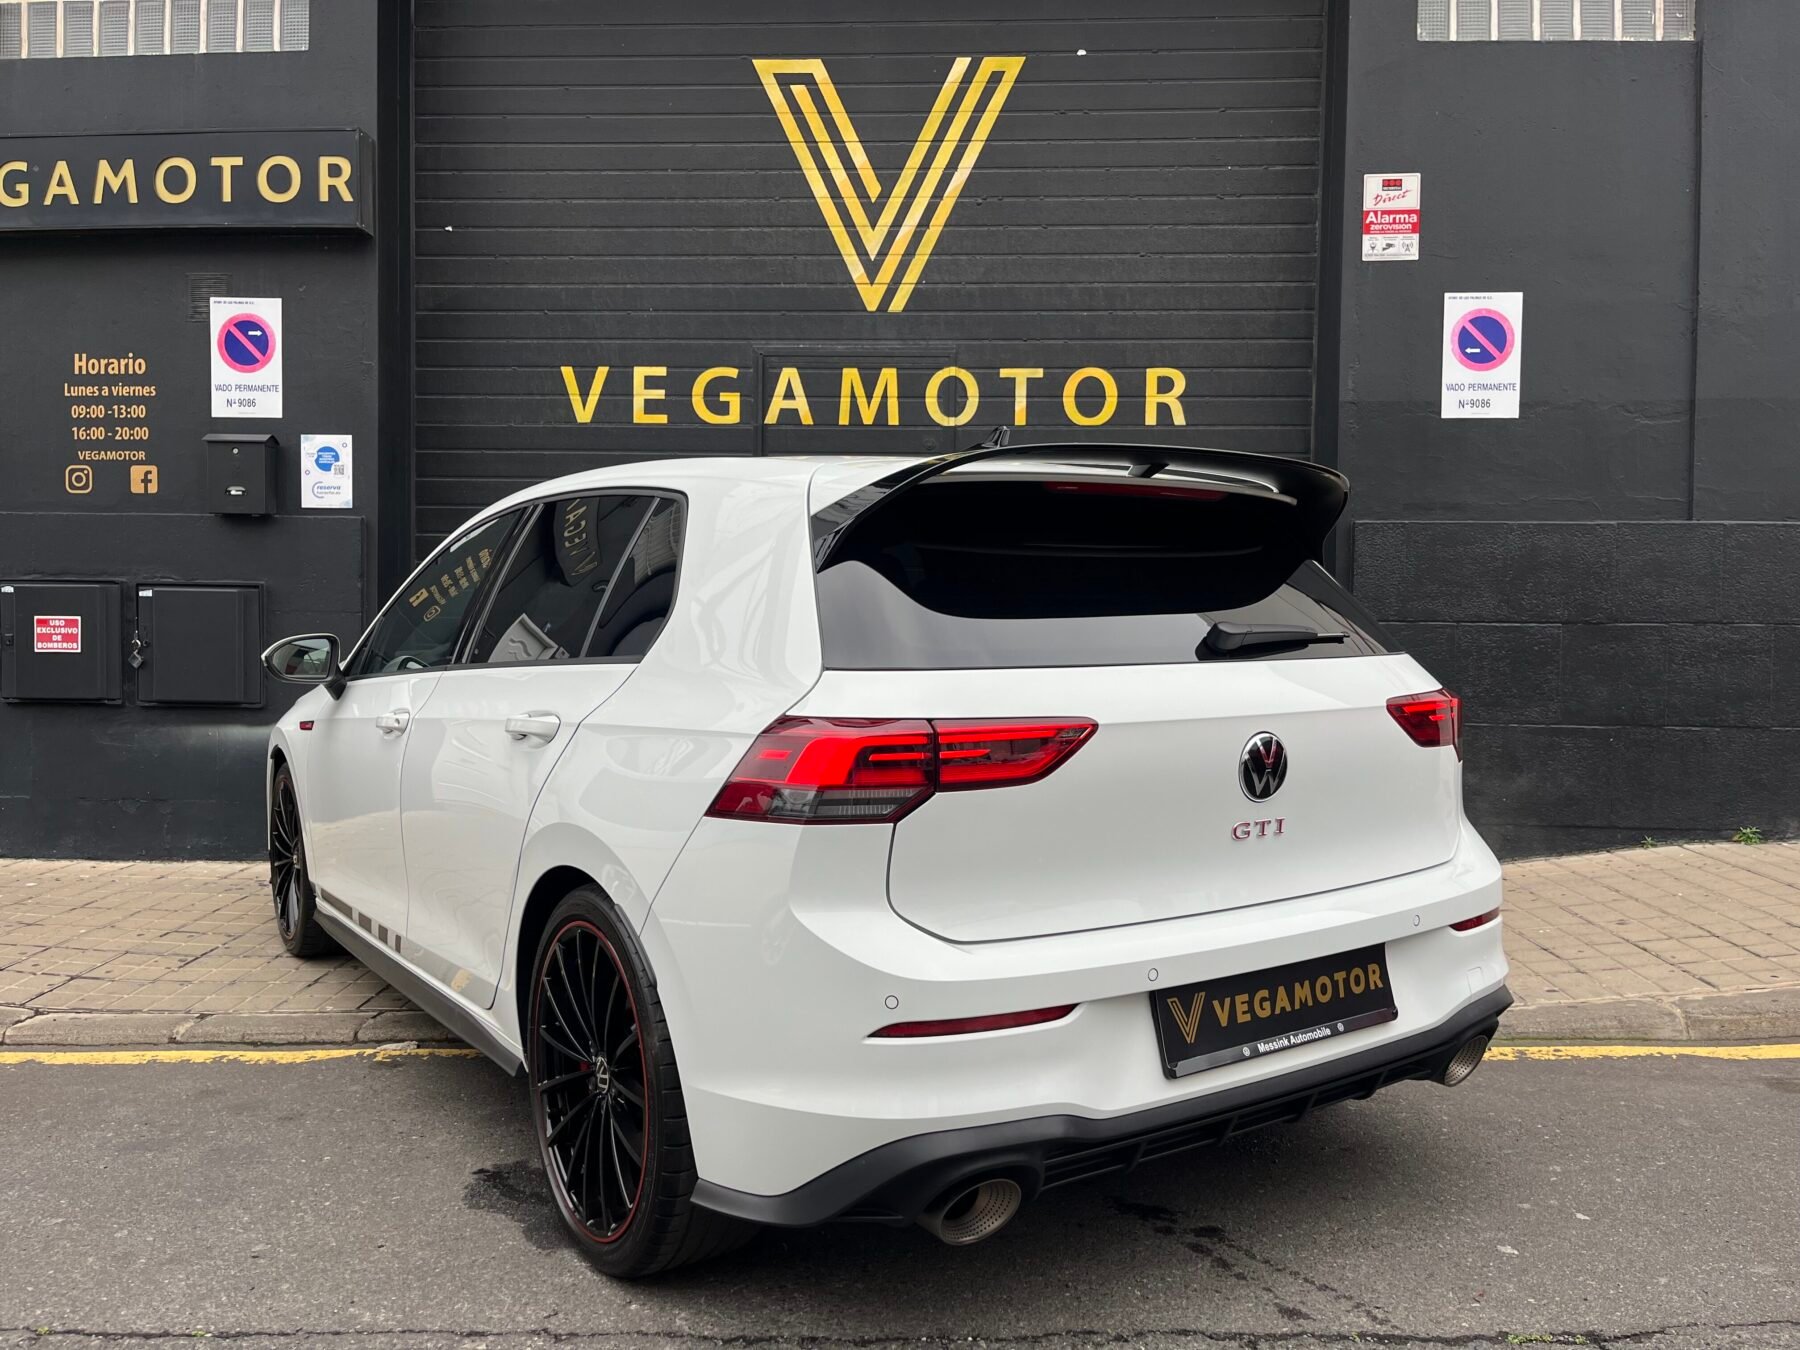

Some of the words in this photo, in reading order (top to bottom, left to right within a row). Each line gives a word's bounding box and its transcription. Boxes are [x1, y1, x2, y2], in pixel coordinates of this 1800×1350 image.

[1373, 189, 1412, 207] Direct
[1365, 211, 1418, 224] Alarma
[1370, 223, 1412, 231] zerovision
[74, 352, 146, 375] Horario
[64, 383, 99, 396] Lunes
[102, 387, 109, 396] a
[112, 383, 156, 396] viernes
[215, 384, 232, 392] VADO
[234, 384, 280, 392] PERMANENTE
[1446, 383, 1466, 391] VADO
[1468, 383, 1517, 391] PERMANENTE
[561, 366, 1187, 426] VEGAMOTOR
[71, 405, 105, 418] 09:00
[72, 427, 105, 440] 16:00
[115, 427, 149, 440] 20:00
[78, 451, 146, 460] VEGAMOTOR
[1232, 817, 1285, 841] GTI
[1213, 963, 1384, 1027] VEGAMOTOR
[1257, 1036, 1290, 1053] Messink
[1290, 1027, 1332, 1045] Automobile
